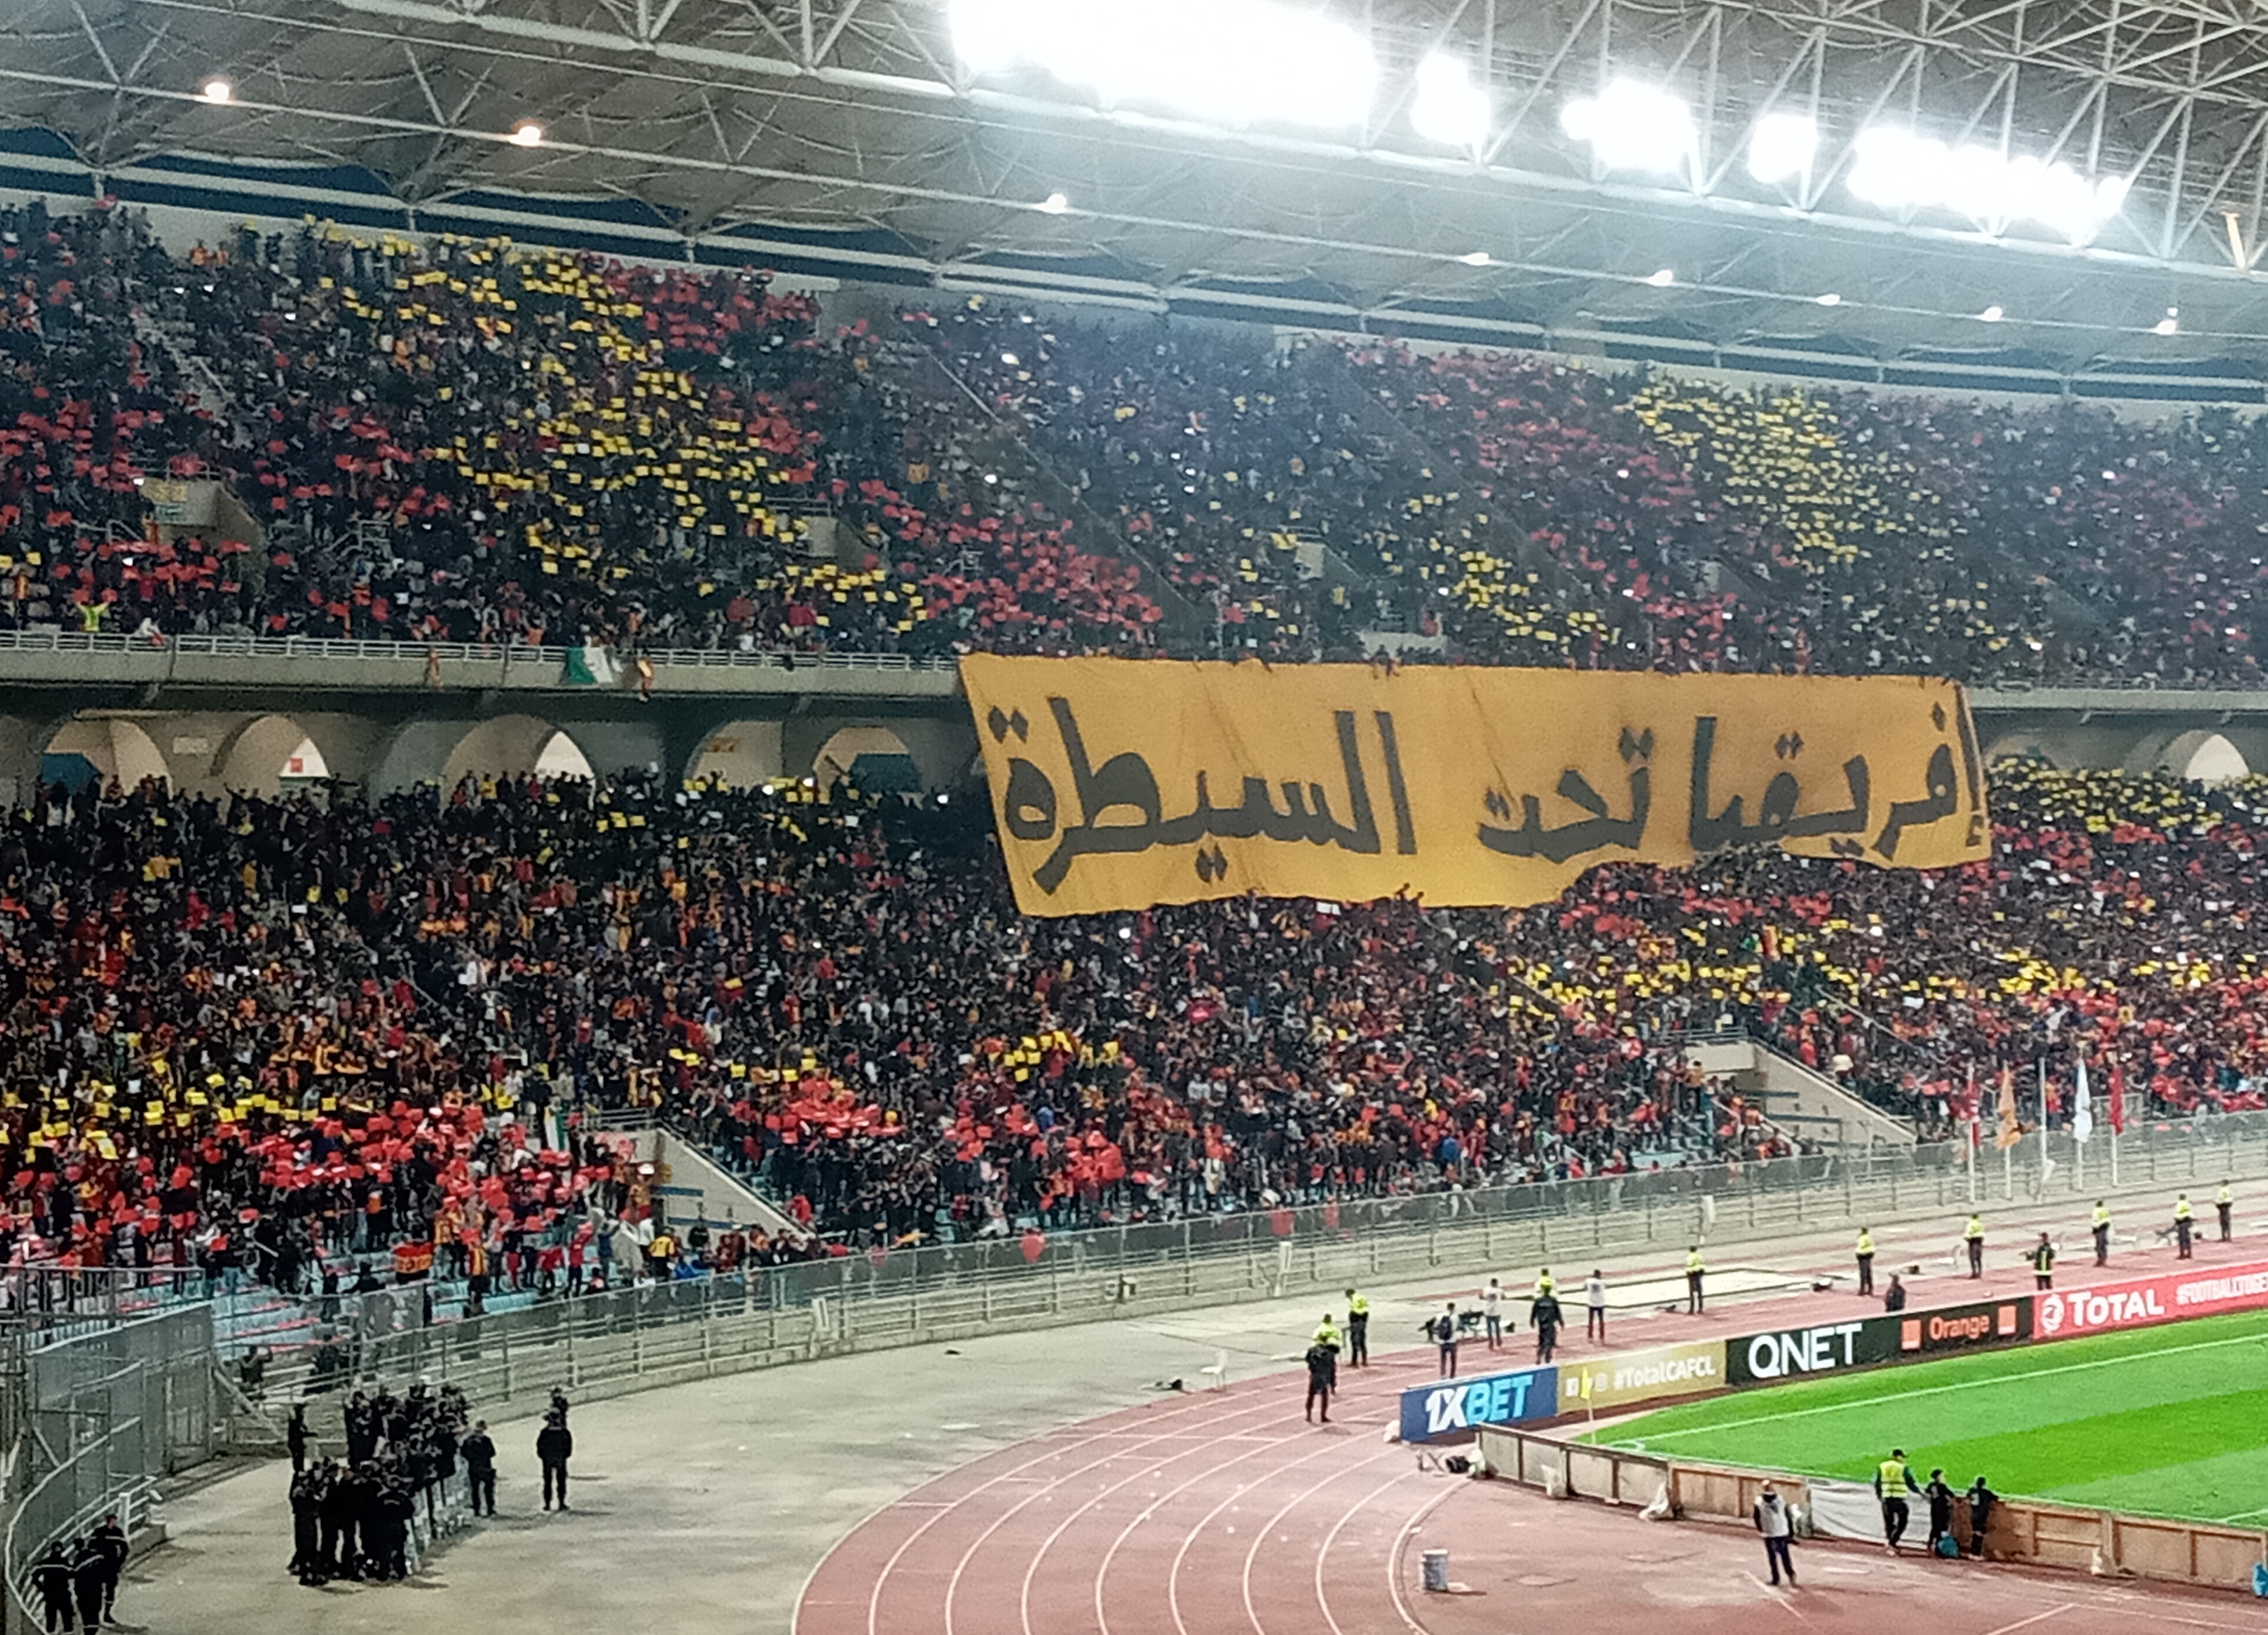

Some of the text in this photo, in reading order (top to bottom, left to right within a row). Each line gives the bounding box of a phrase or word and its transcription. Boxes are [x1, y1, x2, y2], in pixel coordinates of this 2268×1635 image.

[987, 696, 1418, 895] السيطرة
[1477, 726, 1655, 865] تحت
[1929, 1315, 1989, 1341] Orange
[2067, 1289, 2164, 1326] TOTAL
[1614, 1355, 1716, 1390] #TotalCAFCL
[1748, 1323, 1862, 1379] QNET
[1425, 1374, 1533, 1434] 1XBET
